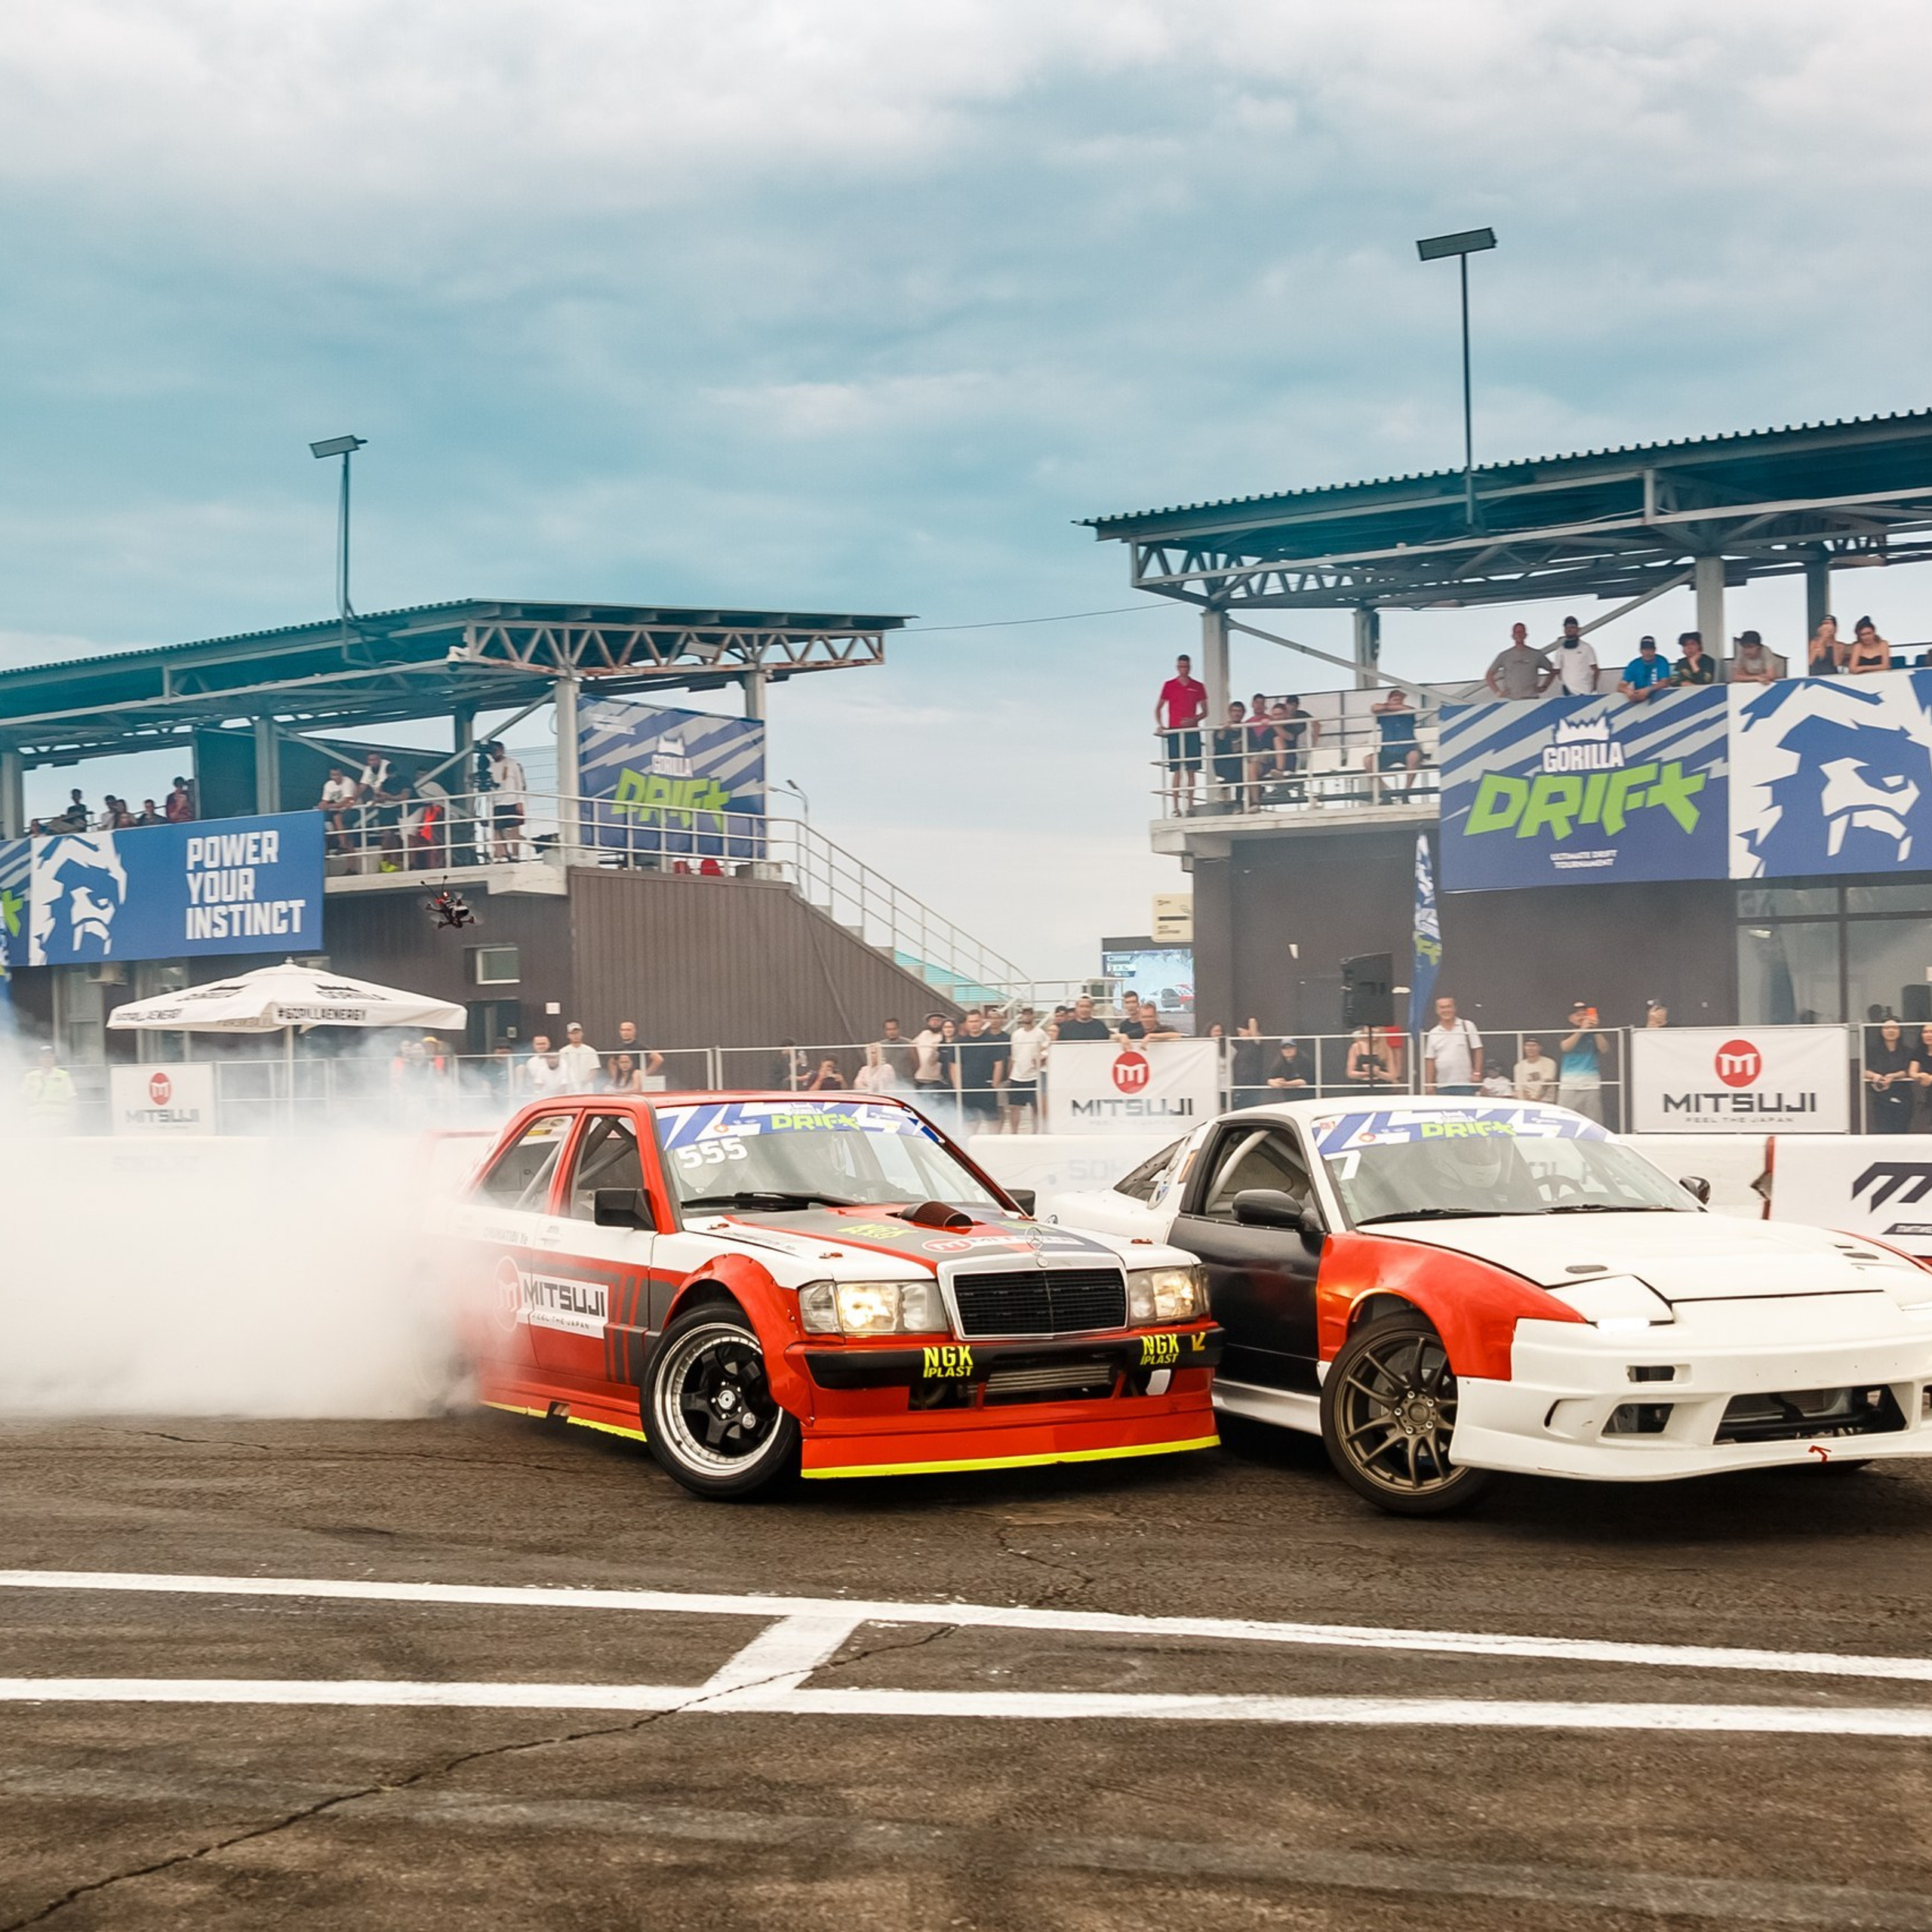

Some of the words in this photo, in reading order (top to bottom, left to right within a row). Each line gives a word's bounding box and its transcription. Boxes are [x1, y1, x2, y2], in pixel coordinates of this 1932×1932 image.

[651, 755, 693, 777] GORILLA
[1543, 741, 1625, 773] GORILLA
[186, 830, 278, 870] POWER
[186, 868, 255, 904] YOUR
[186, 899, 306, 940] INSTINCT
[1071, 1098, 1194, 1117] MITSUJI
[1663, 1093, 1817, 1113] MITSUJI
[679, 1137, 748, 1169] 555
[524, 1279, 605, 1317] MITSUJI
[922, 1345, 974, 1367] NGK
[1141, 1334, 1180, 1356] NGK
